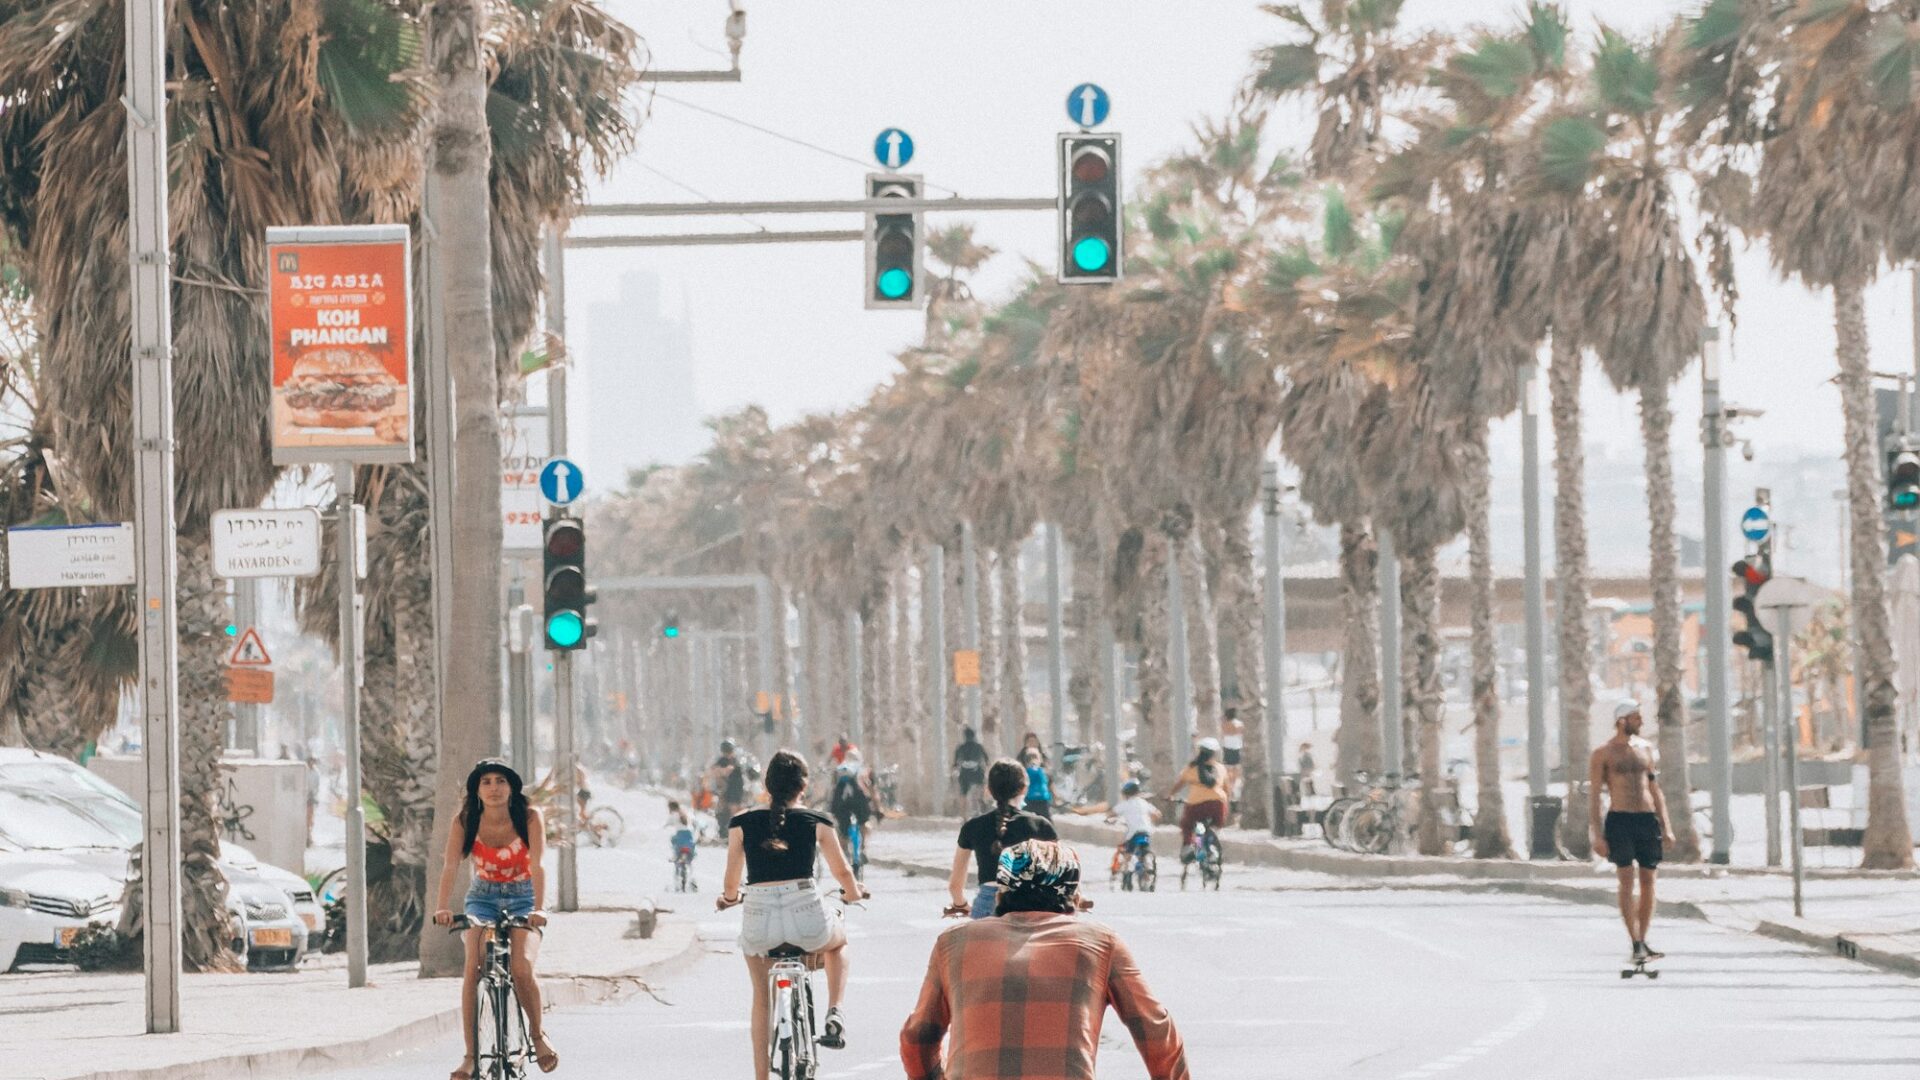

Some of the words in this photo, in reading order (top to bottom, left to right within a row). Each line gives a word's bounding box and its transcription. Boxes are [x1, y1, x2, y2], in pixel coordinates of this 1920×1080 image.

[290, 274, 327, 290] BIG
[331, 273, 384, 289] ASIA
[316, 308, 360, 327] KOH
[290, 326, 388, 347] PHANGAN
[227, 519, 278, 534] הירדן
[227, 555, 291, 570] HAYARDEN
[60, 570, 106, 580] HaYarden
